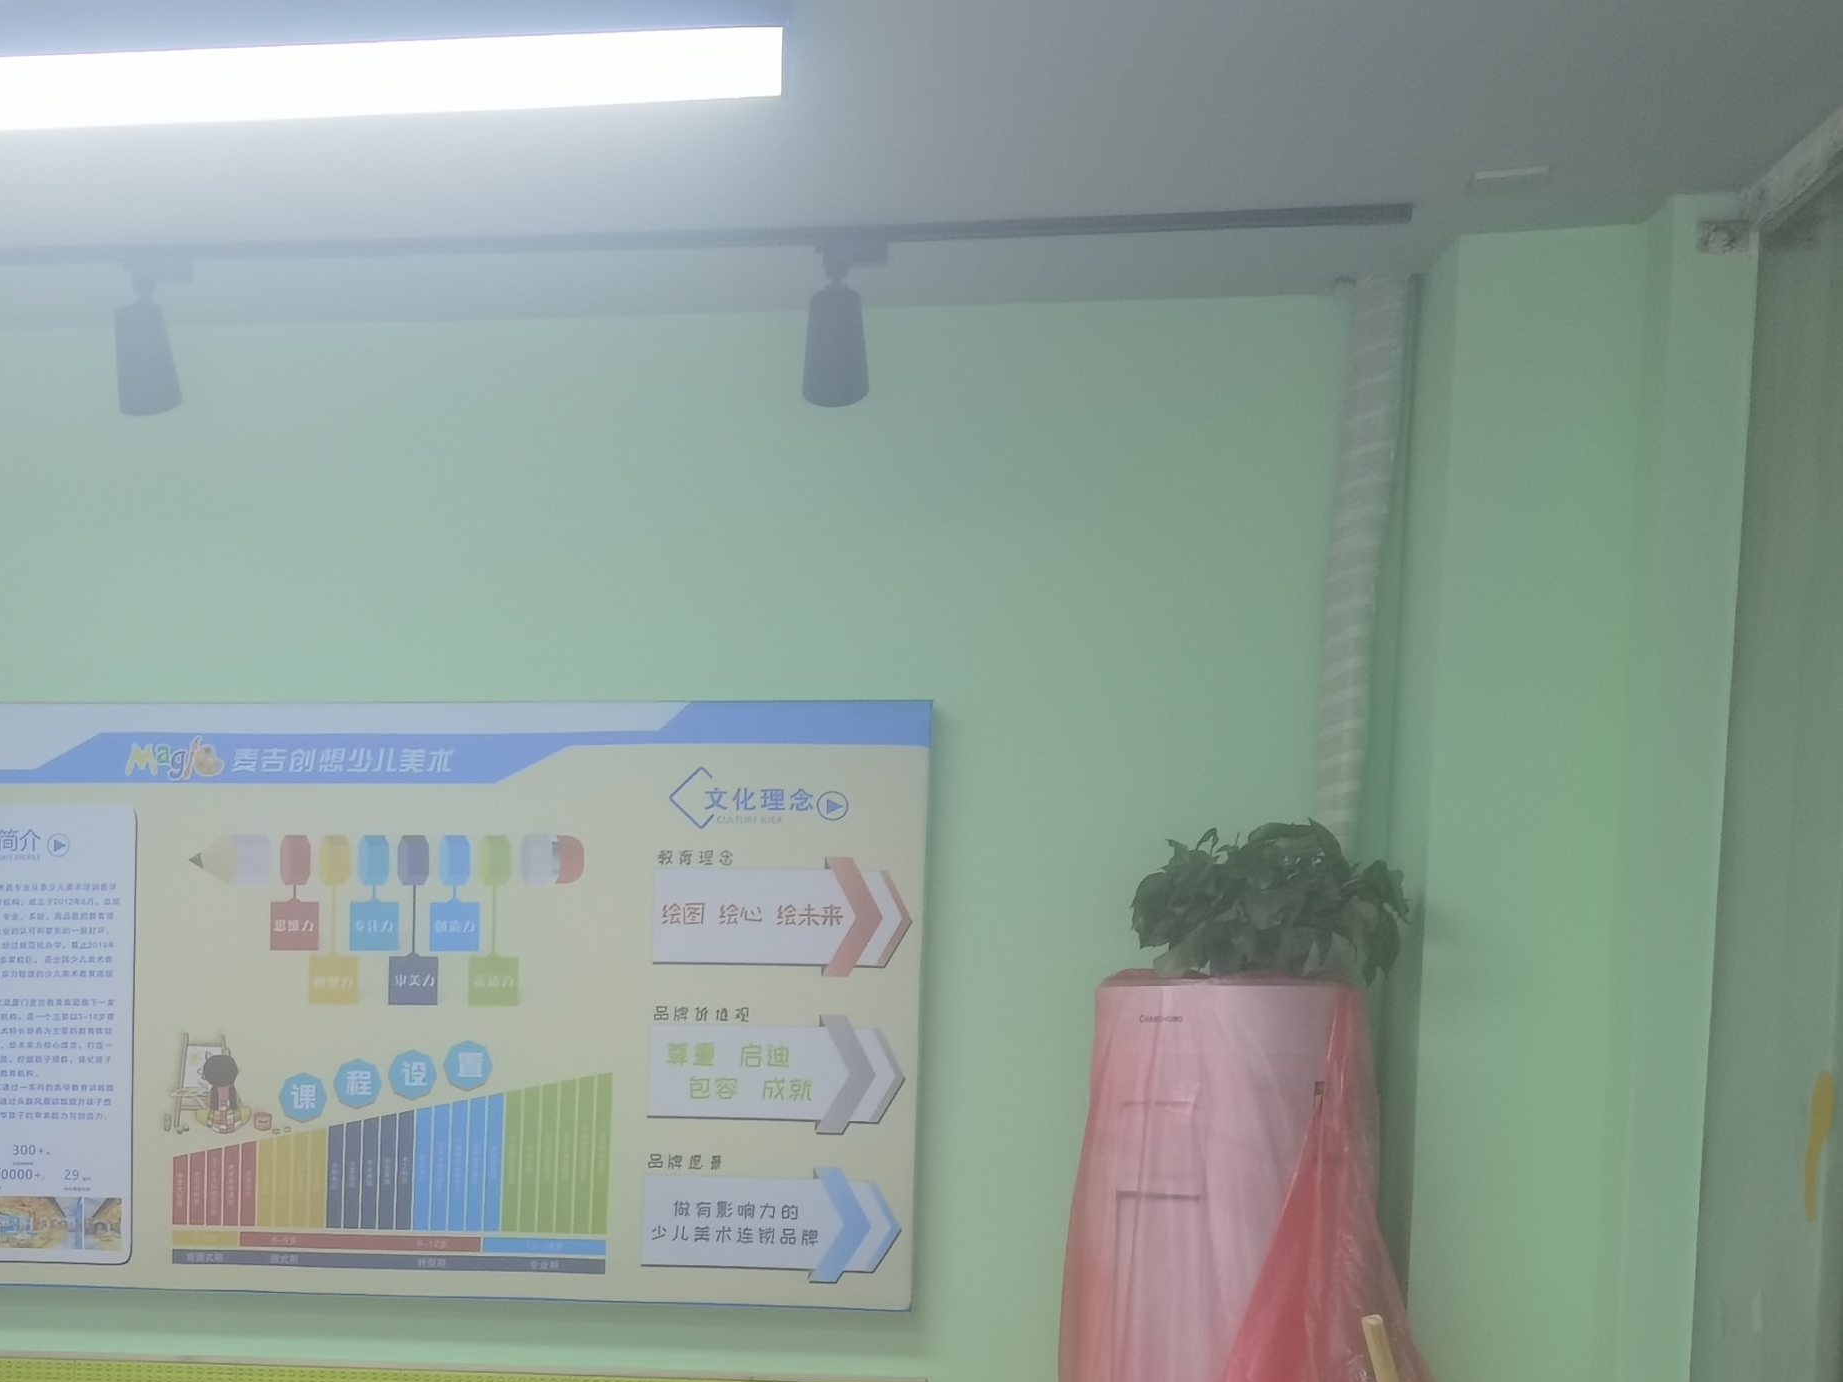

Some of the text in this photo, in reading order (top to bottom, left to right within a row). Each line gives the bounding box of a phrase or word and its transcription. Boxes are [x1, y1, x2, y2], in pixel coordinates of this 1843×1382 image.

[231, 748, 454, 774] 麦吉创想少儿美术
[705, 787, 814, 813] 文化理念
[657, 850, 734, 866] 教育理念
[274, 919, 315, 933] 思维力
[661, 903, 843, 927] 绘图 绘心 绘未来
[394, 974, 435, 988] 审美力
[653, 1006, 750, 1023] 品牌价值观
[666, 1042, 791, 1069] 尊重 启迪
[688, 1075, 813, 1102] 包容 成就
[647, 1153, 722, 1171] 品牌愿景
[673, 1200, 799, 1221] 做有影响力的
[651, 1225, 820, 1248] 少儿美术连锁品牌
